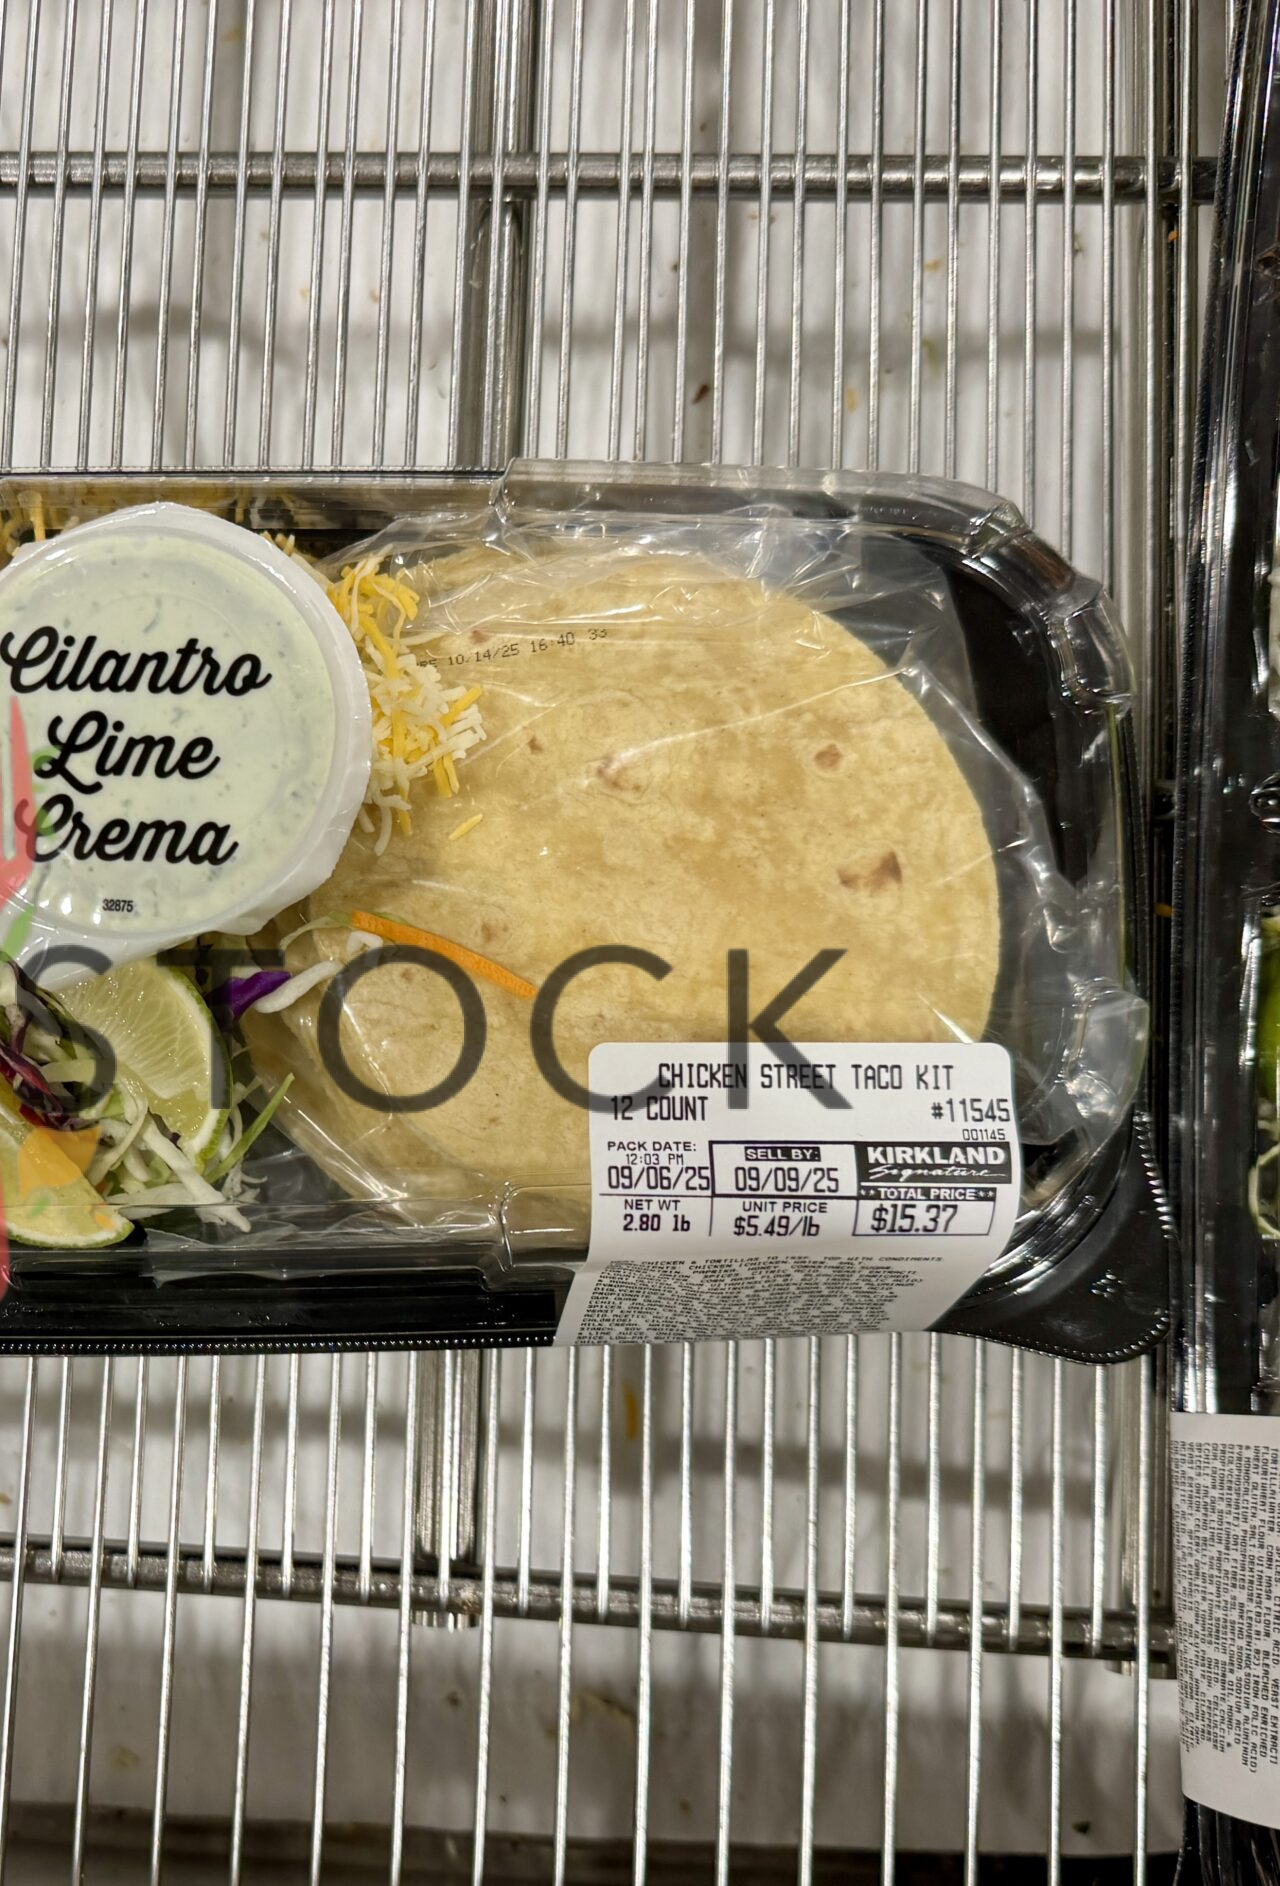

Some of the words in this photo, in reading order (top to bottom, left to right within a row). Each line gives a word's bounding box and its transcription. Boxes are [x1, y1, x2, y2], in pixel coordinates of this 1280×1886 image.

[0, 626, 272, 697] Cilantro
[34, 711, 221, 795] Lime
[14, 793, 239, 866] Crema
[102, 898, 134, 913] 32875
[658, 1063, 747, 1090] CHICKEN
[761, 1064, 837, 1090] STREET
[852, 1065, 903, 1090] TACO
[916, 1065, 954, 1090] KIT
[610, 1097, 634, 1121] 12
[646, 1096, 708, 1121] COUNT
[931, 1098, 1010, 1123] #11545
[962, 1128, 1006, 1141] 001145
[608, 1141, 647, 1152] PACK
[652, 1141, 697, 1153] DATE:
[746, 1148, 787, 1160] SELL
[792, 1148, 820, 1160] BY:
[867, 1147, 1006, 1165] KIRKLAND
[626, 1154, 660, 1165] 12:03
[668, 1154, 684, 1165] PM
[608, 1166, 710, 1190] 09/06/25
[734, 1167, 839, 1192] 09/09/25
[869, 1163, 1007, 1181] Signature
[878, 1187, 925, 1199] TOTAL
[929, 1187, 976, 1200] PRICE
[625, 1199, 652, 1210] NET
[658, 1199, 680, 1210] WT
[742, 1201, 777, 1212] UNIT
[783, 1202, 828, 1213] PRICE
[623, 1214, 661, 1231] 2.80
[673, 1215, 690, 1231] lb
[734, 1215, 820, 1237] $5.49/lb
[872, 1204, 958, 1234] $15.37
